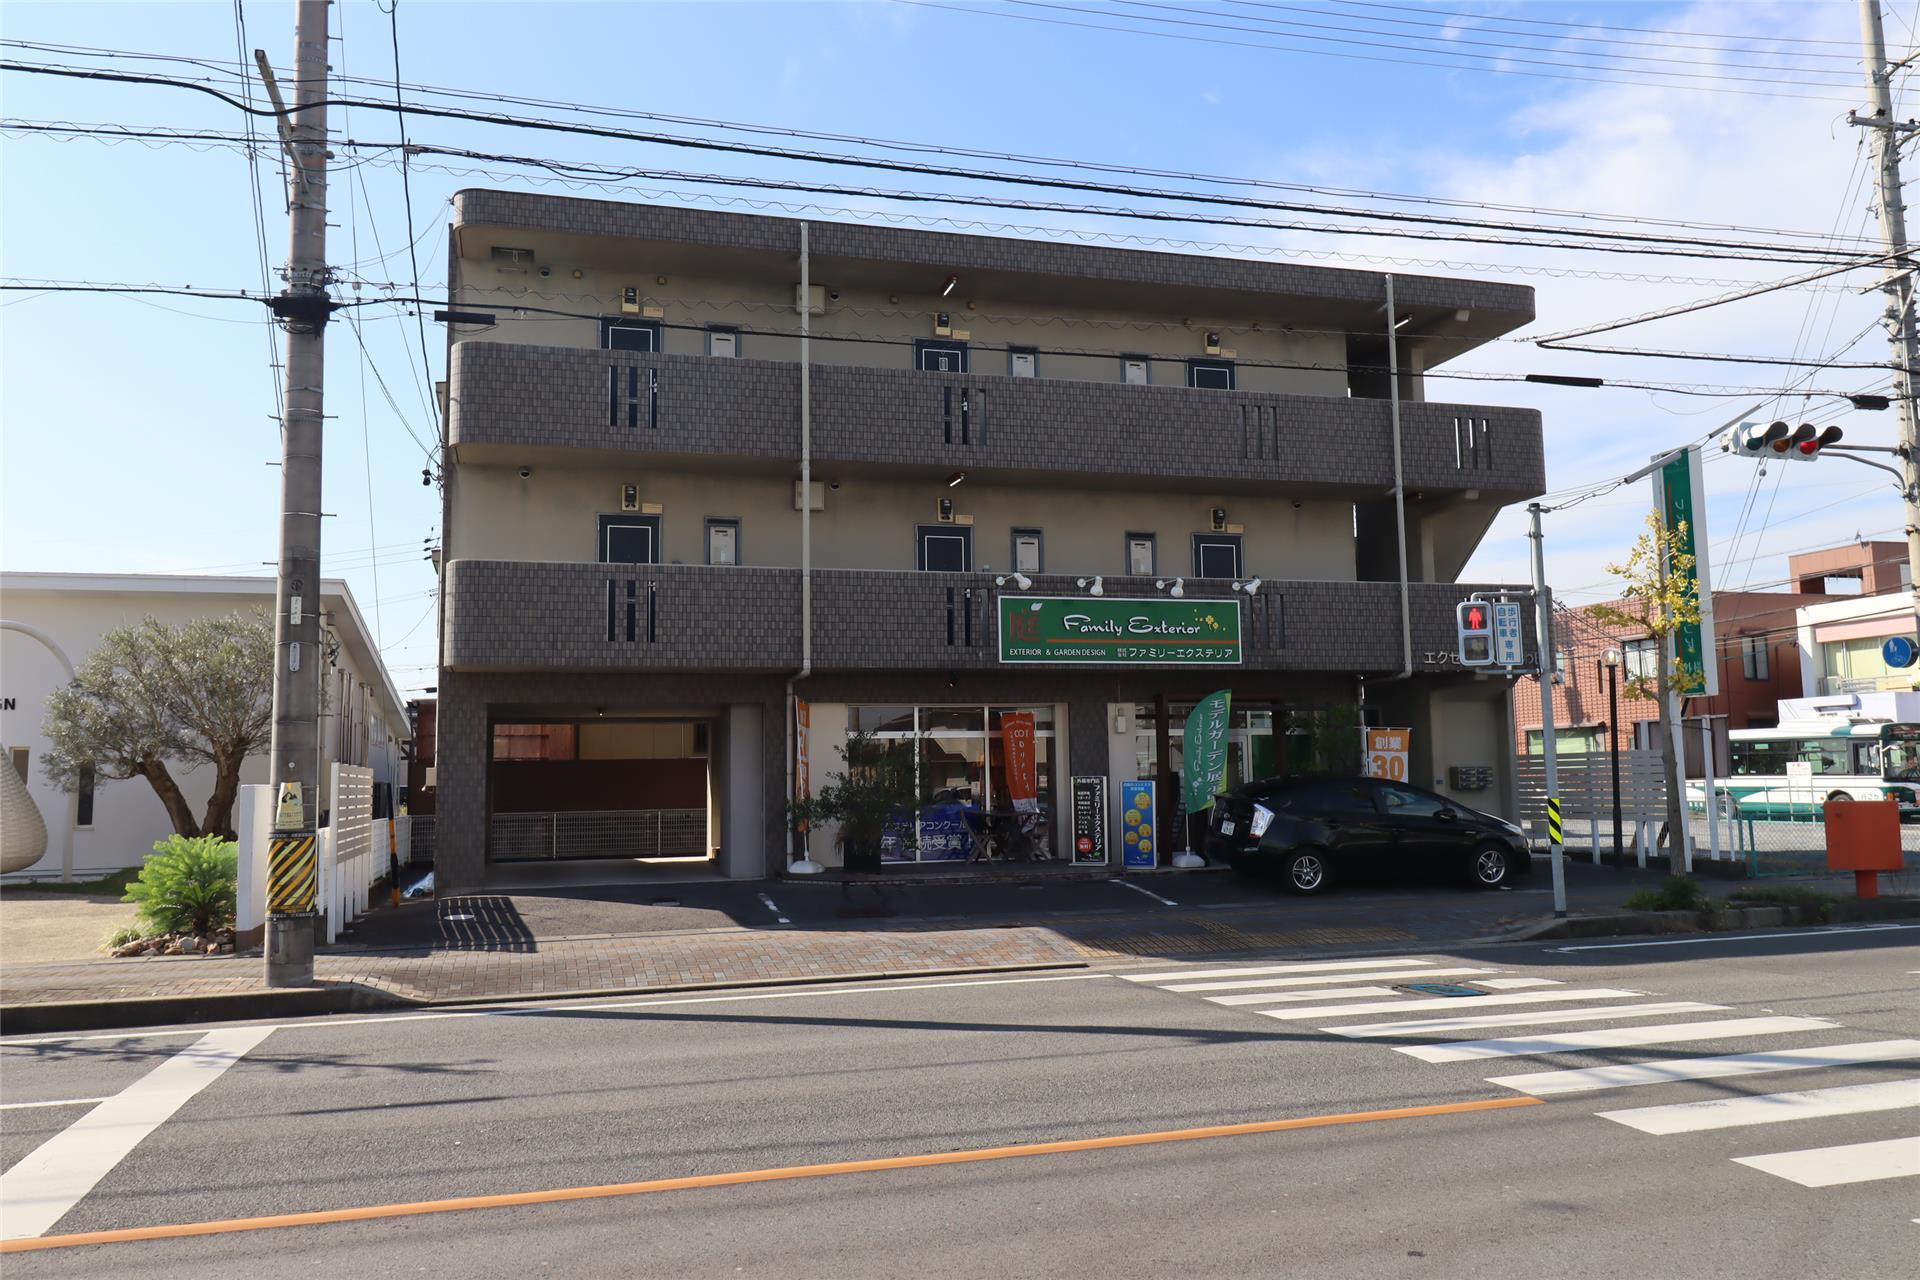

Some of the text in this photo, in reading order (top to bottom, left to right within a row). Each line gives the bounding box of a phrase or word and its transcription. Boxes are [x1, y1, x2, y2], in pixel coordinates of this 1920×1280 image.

[1063, 614, 1123, 636] Family
[1128, 616, 1200, 635] Exterior
[1009, 648, 1042, 656] EXTERIOR
[0, 698, 16, 711] N
[1372, 754, 1404, 780] 30
